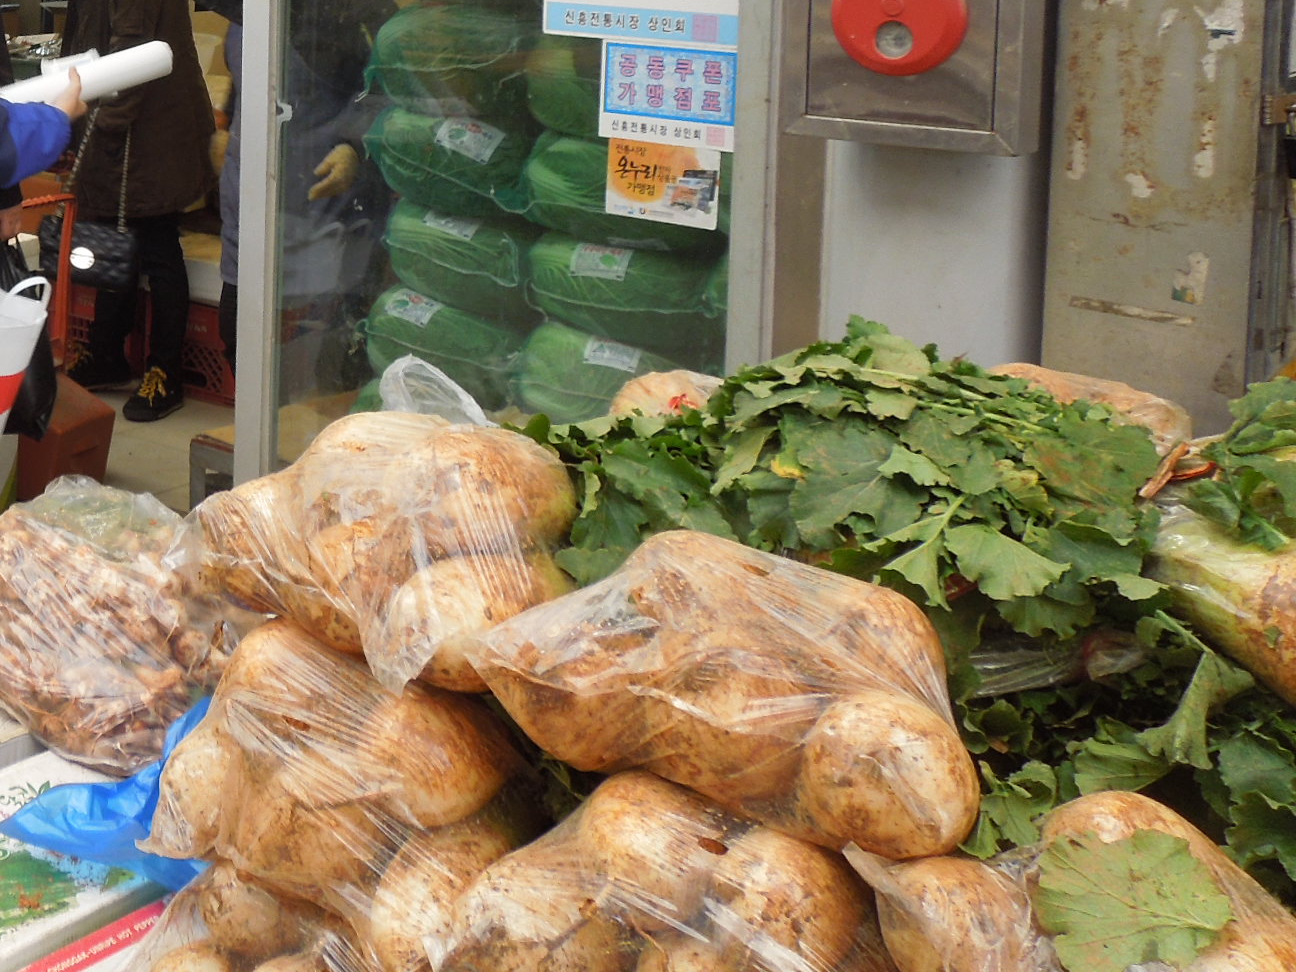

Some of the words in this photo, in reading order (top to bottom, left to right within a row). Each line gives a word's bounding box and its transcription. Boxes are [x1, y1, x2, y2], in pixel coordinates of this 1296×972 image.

[564, 11, 640, 31] 신흥전통시장
[647, 17, 686, 33] 상인회
[618, 54, 723, 85] 공동쿠폰
[617, 82, 722, 112] 가맹점포
[611, 119, 668, 137] 신흥전통시장
[673, 125, 702, 140] 상인회
[614, 155, 657, 183] 온누리
